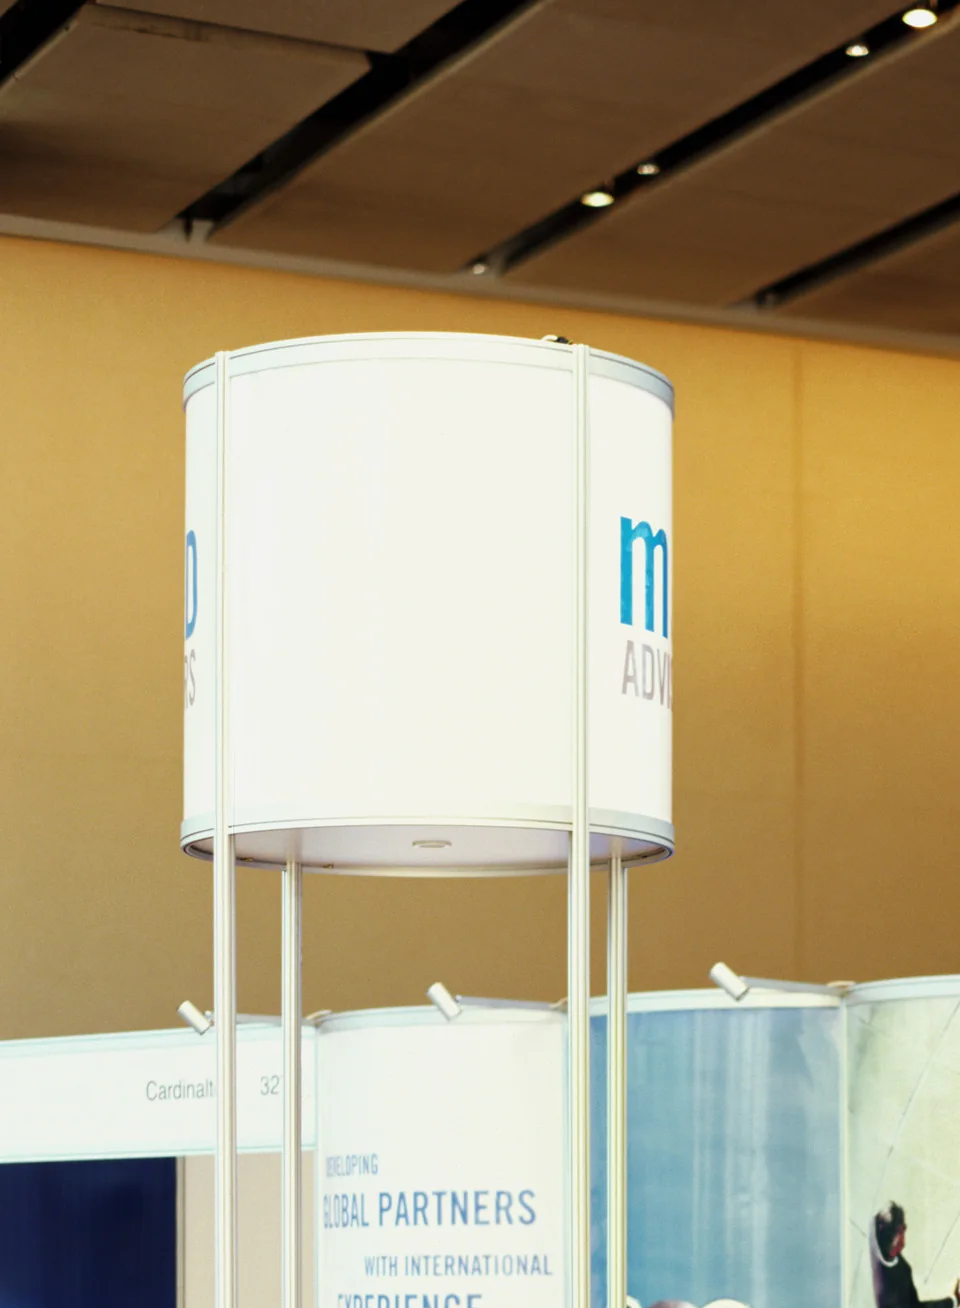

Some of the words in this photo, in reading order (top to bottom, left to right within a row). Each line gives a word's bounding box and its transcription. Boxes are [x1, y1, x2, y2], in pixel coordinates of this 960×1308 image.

[620, 516, 668, 638] m
[260, 1074, 283, 1096] 32
[323, 1193, 369, 1228] GLOBAL
[379, 1190, 536, 1226] PARTNERS
[364, 1255, 398, 1277] WITH
[404, 1254, 553, 1276] INTERNATIONAL
